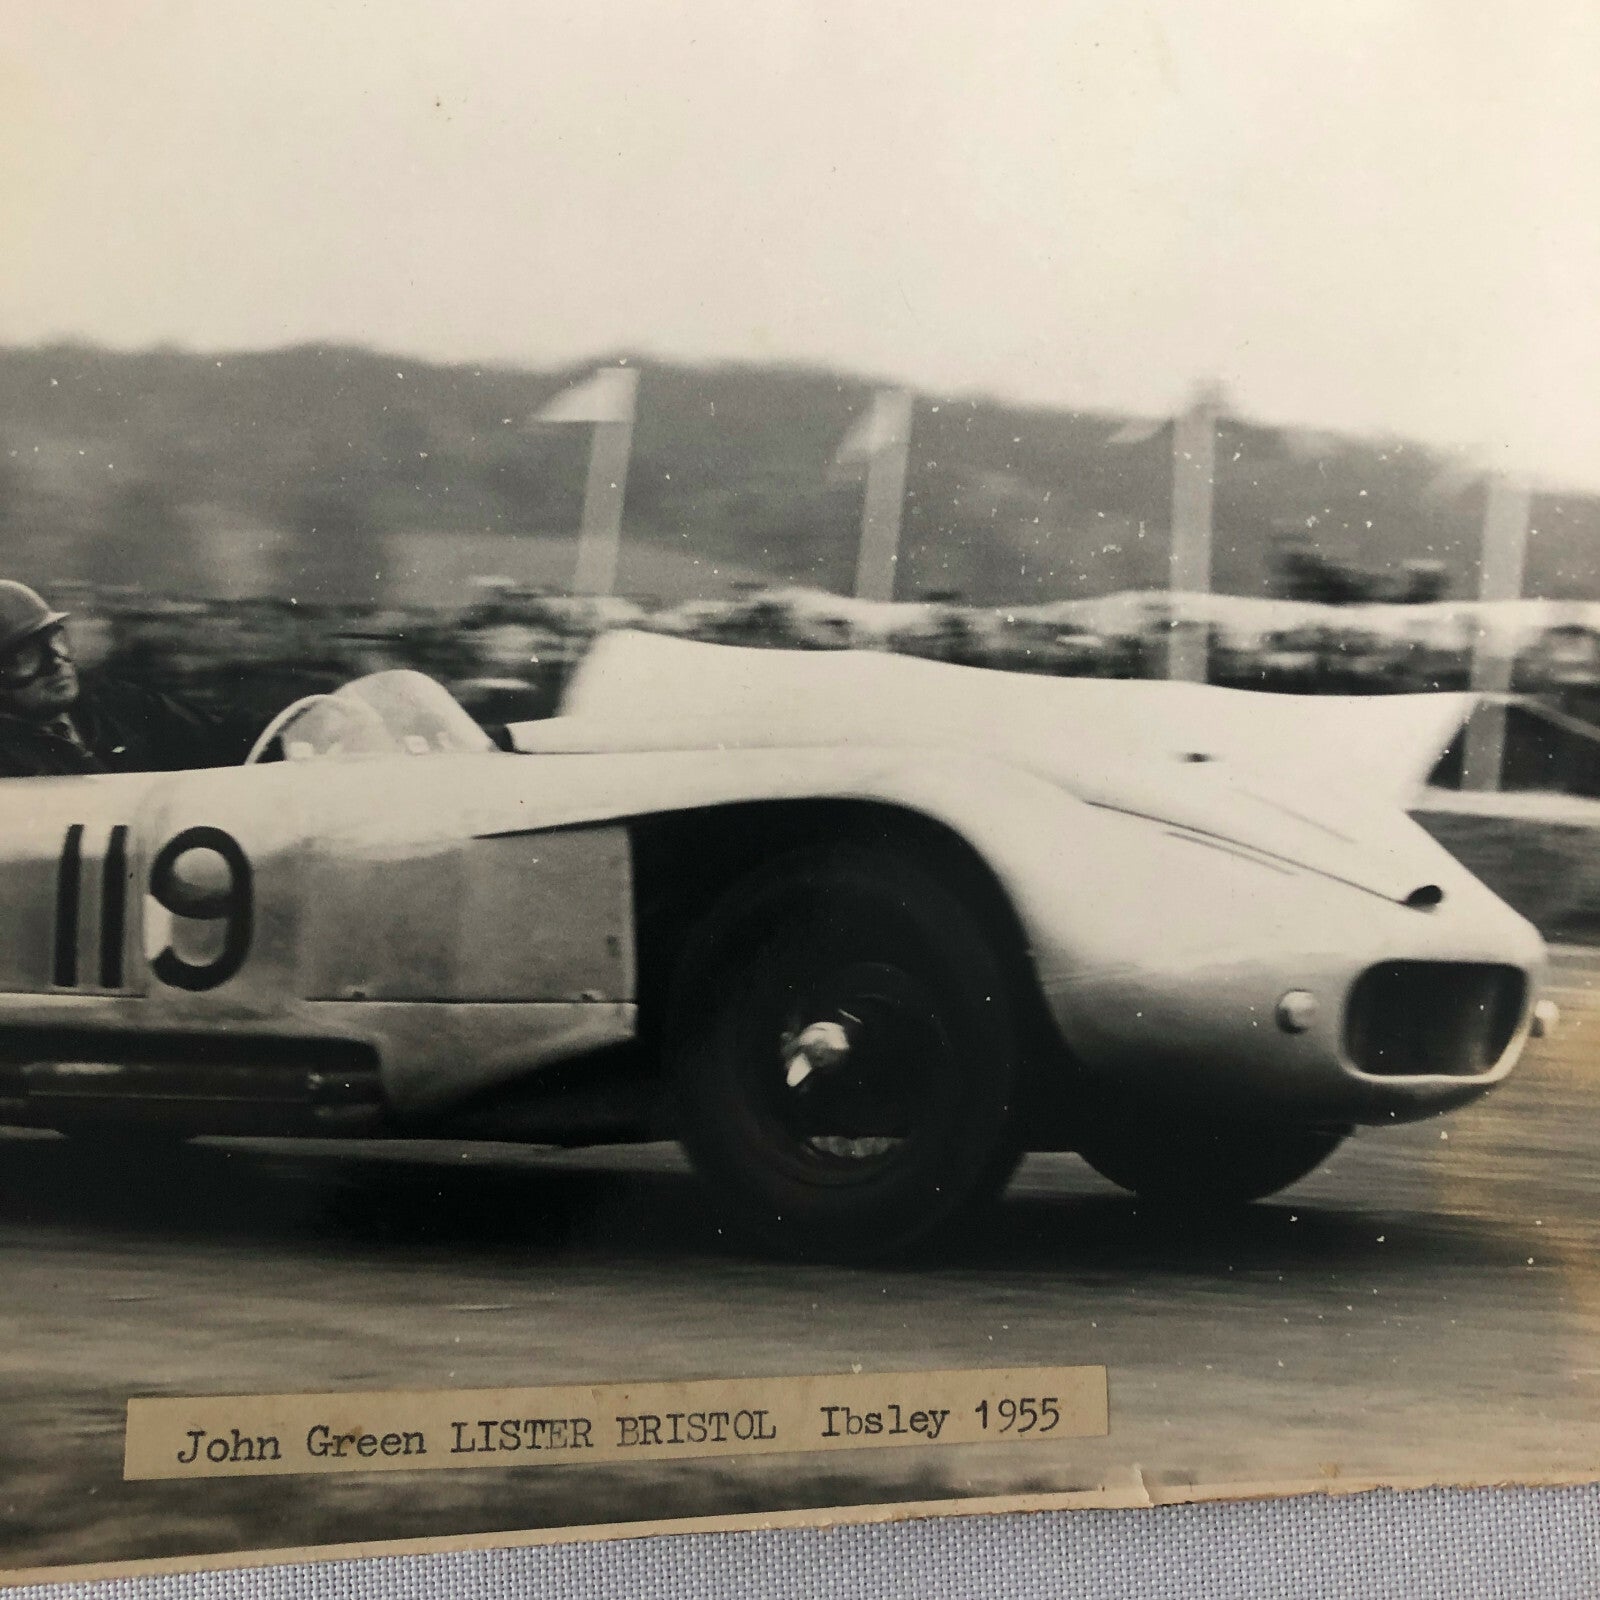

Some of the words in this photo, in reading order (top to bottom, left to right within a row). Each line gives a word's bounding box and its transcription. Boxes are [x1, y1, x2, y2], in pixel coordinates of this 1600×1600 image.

[52, 823, 254, 993] 119
[176, 1428, 282, 1464] John
[306, 1423, 428, 1458] Green
[449, 1416, 595, 1454] LISTER
[615, 1409, 777, 1448] BRISTOL
[819, 1403, 951, 1440] Ibsley
[974, 1397, 1060, 1434] 1955
